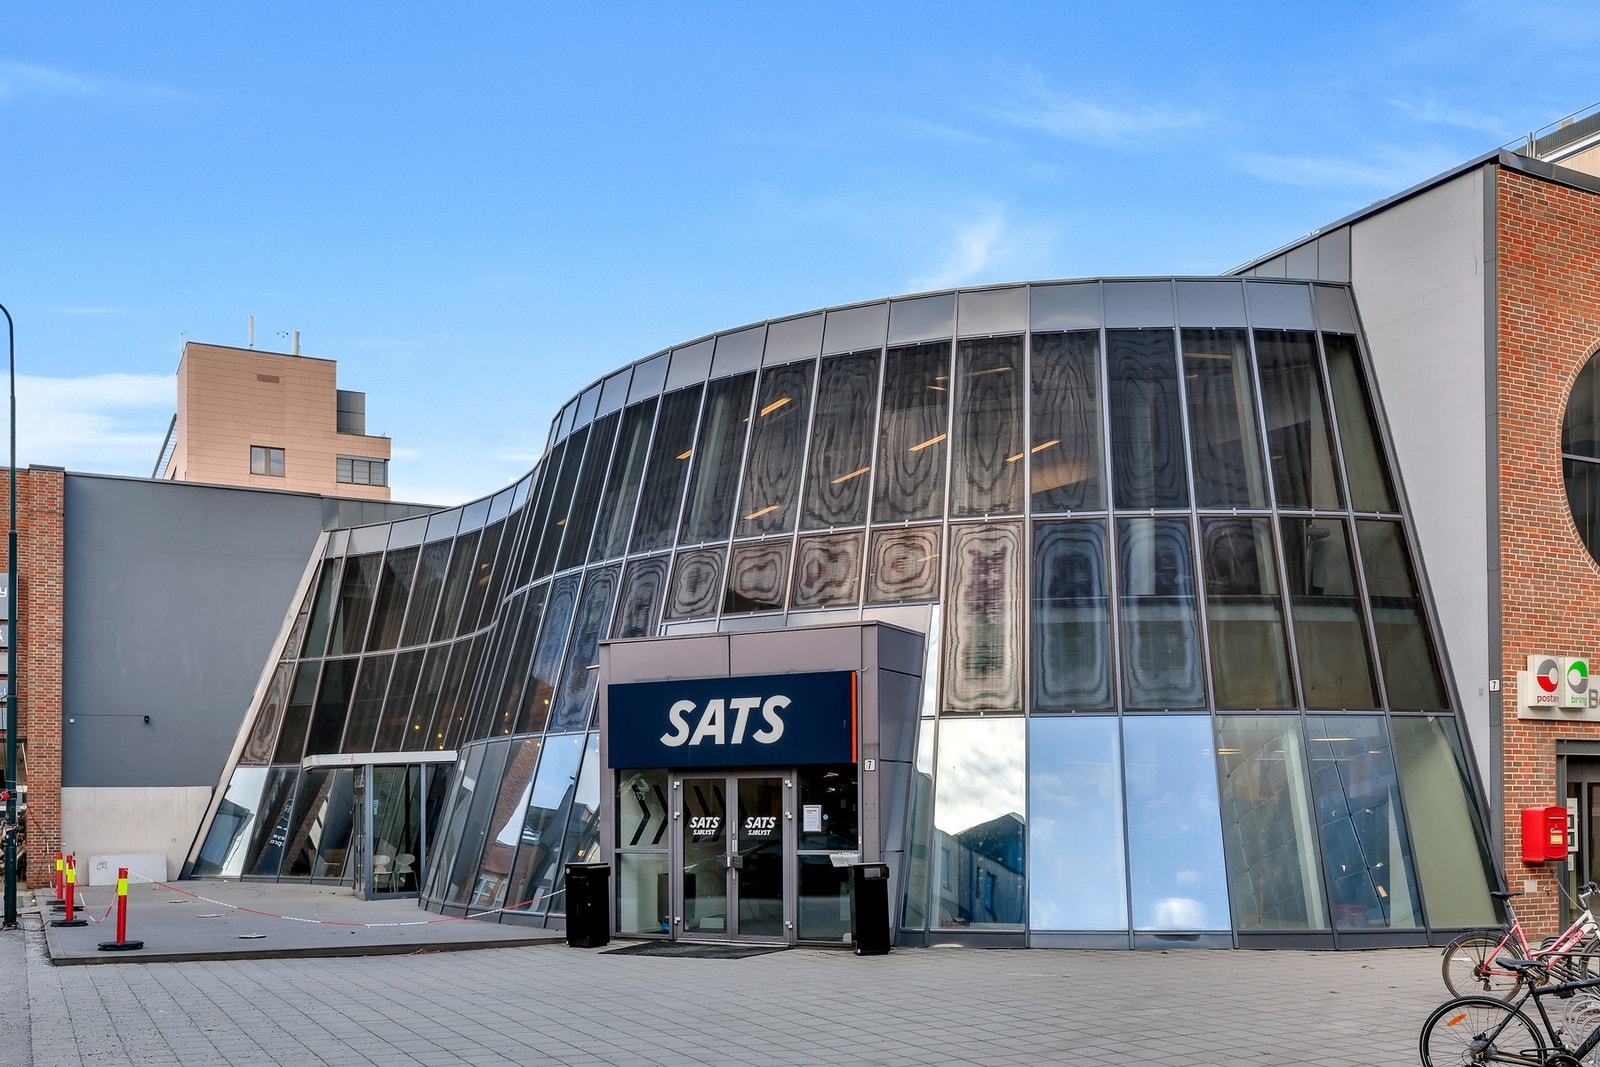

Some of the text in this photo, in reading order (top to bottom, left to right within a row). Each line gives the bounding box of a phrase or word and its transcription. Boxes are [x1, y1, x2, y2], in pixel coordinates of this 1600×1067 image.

[1536, 694, 1559, 703] posten
[1571, 695, 1587, 706] bring
[660, 695, 792, 747] SATS
[689, 816, 721, 829] SATS
[744, 816, 777, 829] SATS
